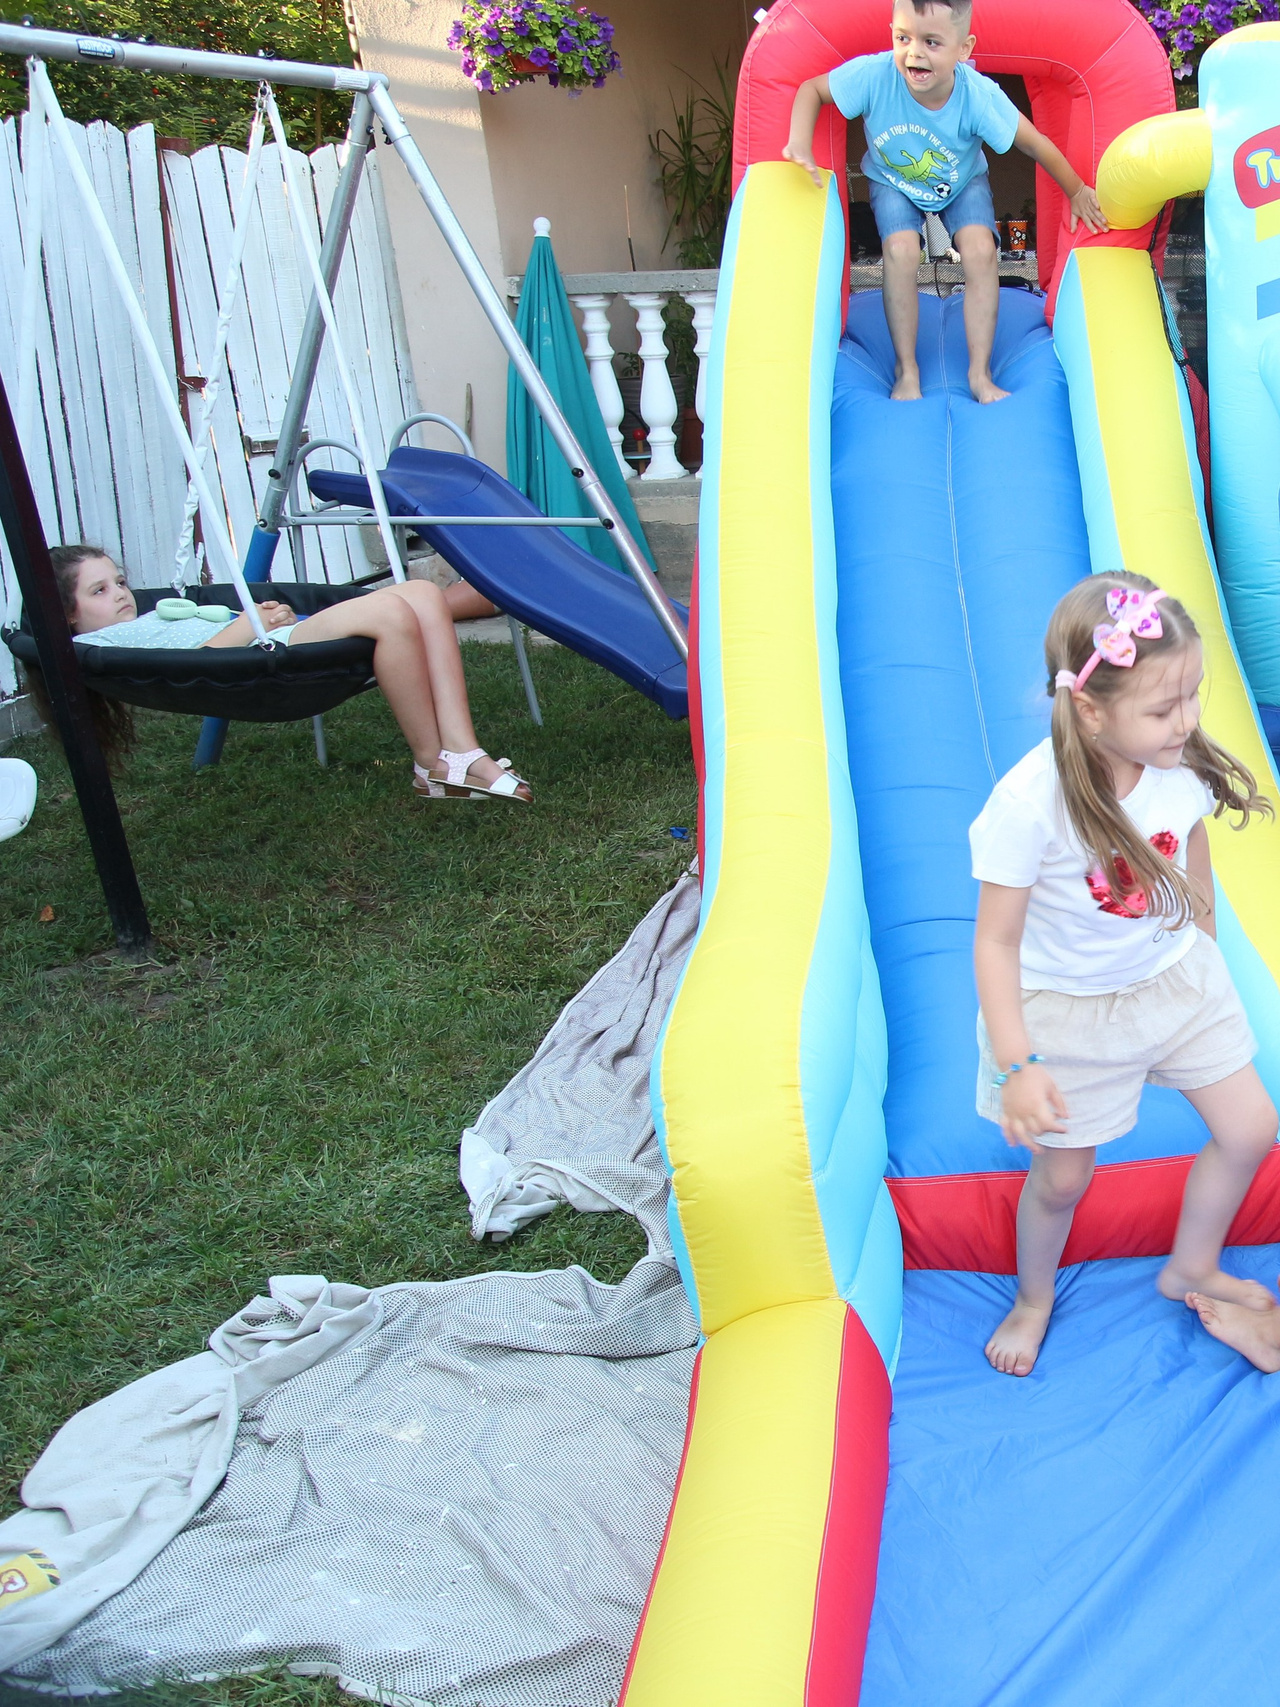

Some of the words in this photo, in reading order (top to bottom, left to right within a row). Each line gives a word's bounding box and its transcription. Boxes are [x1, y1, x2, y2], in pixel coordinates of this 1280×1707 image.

[889, 123, 908, 137] THEM
[909, 123, 929, 137] HOW
[928, 133, 942, 147] THE
[897, 180, 922, 197] DINO
